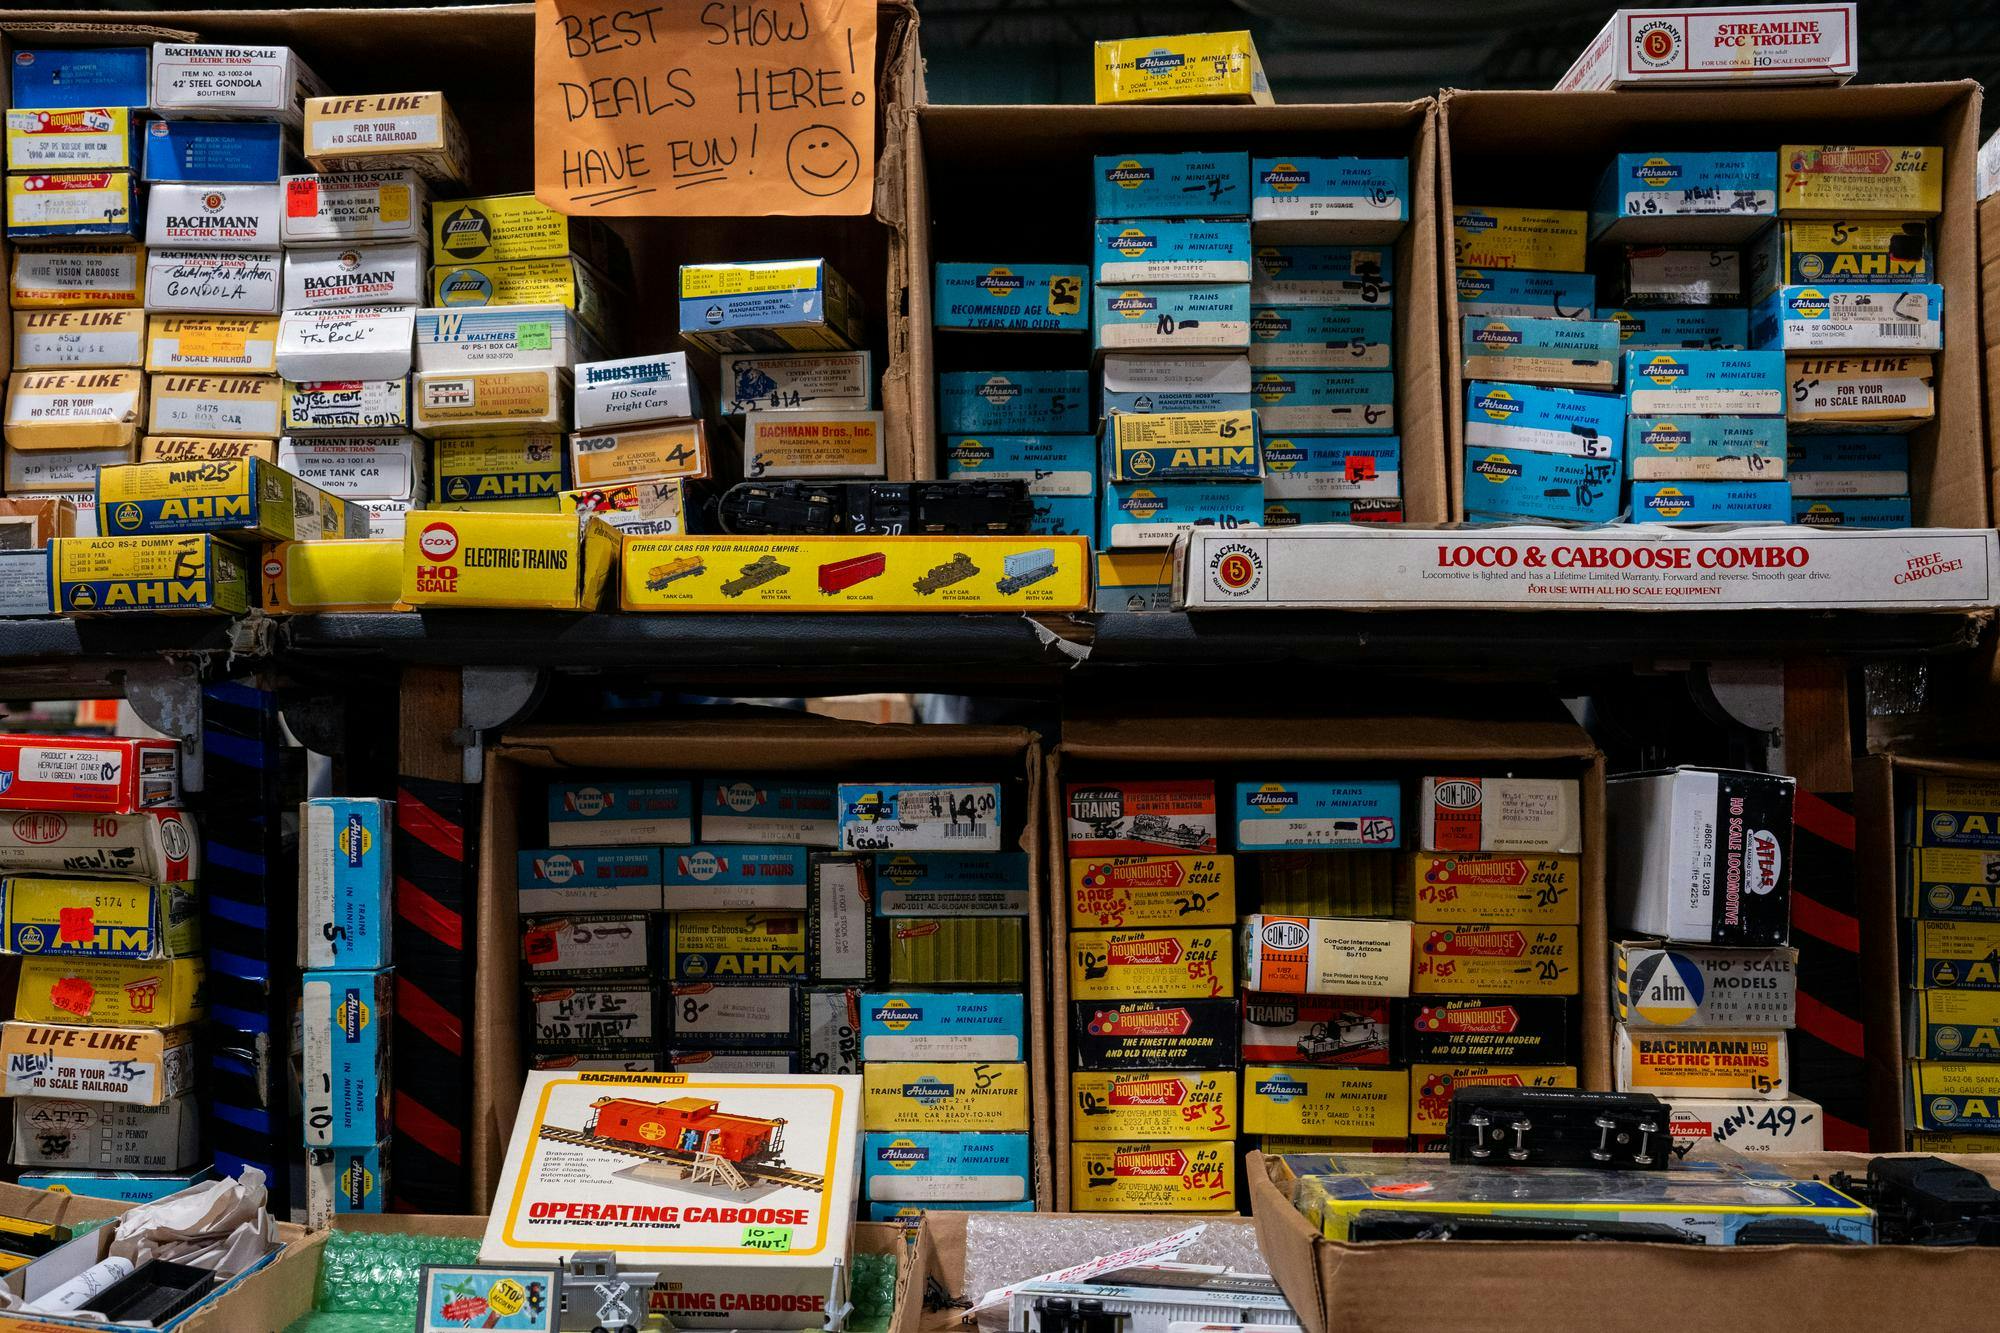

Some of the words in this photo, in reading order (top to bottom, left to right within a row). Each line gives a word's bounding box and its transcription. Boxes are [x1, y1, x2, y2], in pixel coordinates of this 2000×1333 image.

[556, 7, 663, 58] BEST
[701, 2, 810, 46] SHOW
[1633, 21, 1683, 45] BACHMANN
[1718, 21, 1820, 35] STREAMLINE
[1714, 35, 1745, 48] PCC
[1750, 33, 1822, 48] TROLLEY
[165, 47, 222, 57] BACHMANN
[225, 49, 241, 58] HO
[243, 49, 277, 58] SCALE
[189, 79, 212, 88] STEEL
[215, 79, 263, 89] GONDOLA
[558, 68, 696, 121] DEALS
[320, 96, 423, 115] LIFE-LIKE
[353, 124, 369, 132] FOR
[372, 122, 396, 131] YOUR
[331, 136, 344, 144] HO
[346, 134, 373, 143] SCALE
[375, 132, 418, 143] RAILROAD
[562, 143, 651, 190] HAVE
[166, 215, 259, 228] BACHMANN
[166, 229, 214, 237] ELECTRIC
[216, 228, 257, 237] TRAINS
[55, 267, 84, 277] VISION
[86, 268, 121, 278] CABOOSE
[167, 281, 247, 299] GONDOLA
[951, 304, 1022, 316] RECOMMENDED
[1024, 304, 1043, 315] AGE
[976, 318, 1005, 329] YEARS
[1008, 318, 1029, 329] AND
[1031, 318, 1061, 329] OLDER
[466, 332, 516, 342] WALTHERS
[586, 362, 670, 383] INDUSTRIAL
[1642, 364, 1686, 376] Athearn
[1802, 357, 1909, 375] LIFE-LIKE
[1706, 371, 1715, 379] IN
[1719, 370, 1768, 379] MINIATURE
[611, 390, 627, 400] HO
[629, 387, 658, 399] Scale
[1837, 386, 1855, 396] FOR
[1858, 385, 1883, 394] YOUR
[605, 400, 642, 413] Freight
[643, 398, 669, 410] Cars
[1815, 398, 1828, 407] HO
[1831, 396, 1858, 406] SCALE
[1861, 394, 1907, 405] RAILROAD
[159, 495, 250, 520] AHM
[91, 540, 115, 549] ALCO
[118, 540, 138, 549] RS-2
[141, 538, 175, 549] DUMMY
[424, 537, 454, 547] COX
[632, 543, 656, 553] OTHER
[657, 544, 671, 553] COX
[672, 544, 693, 553] CARS
[695, 544, 709, 553] FOR
[711, 544, 731, 553] YOUR
[732, 544, 770, 554] RAILROAD
[464, 548, 521, 570] ELECTRIC
[522, 549, 568, 571] TRAINS
[1210, 543, 1264, 570] BACHMANN
[1438, 546, 1518, 568] LOCO
[1523, 546, 1547, 568] &
[1551, 546, 1691, 569] CABOOSE
[1697, 546, 1810, 569] COMBO
[1906, 551, 1944, 569] FREE
[415, 566, 458, 579] HO
[1422, 570, 1470, 580] Locomotive
[1472, 571, 1479, 579] is
[1481, 571, 1509, 581] lighted
[1511, 571, 1527, 580] and
[1529, 571, 1543, 580] has
[1553, 571, 1587, 580] Lifetime
[1589, 571, 1619, 581] Limited
[1663, 572, 1697, 581] Forward
[1699, 572, 1716, 581] and
[1752, 571, 1785, 581] Smooth
[1787, 573, 1805, 582] gear
[1893, 558, 1964, 586] CABOOSE!
[415, 579, 458, 593] SCALE
[1528, 586, 1548, 595] FOR
[1550, 586, 1567, 594] USE
[1569, 586, 1595, 595] WITH
[1596, 587, 1615, 595] ALL
[1616, 587, 1630, 595] HO
[1633, 587, 1663, 595] SCALE
[1665, 586, 1722, 596] EQUIPMENT
[104, 581, 208, 606] AHM
[1730, 797, 1744, 816] HO
[1728, 818, 1744, 852] SCALE
[1755, 836, 1775, 890] ATLAS
[1702, 873, 1711, 896] U23B
[1725, 853, 1743, 925] LOCOMOTIVE
[1267, 926, 1305, 943] CON-COR
[1744, 960, 1790, 972] SCALE
[1651, 974, 1686, 1004] ahm
[1713, 977, 1777, 989] MODELS
[27, 1029, 143, 1051] LIFE-LIKE
[1123, 1037, 1138, 1047] THE
[1139, 1037, 1166, 1047] FINEST
[1168, 1037, 1176, 1046] IN
[1178, 1037, 1213, 1046] MODERN
[1639, 1040, 1749, 1054] BACHMANN
[1105, 1048, 1122, 1058] AND
[1123, 1048, 1139, 1058] OLD
[1141, 1048, 1166, 1058] TIMER
[1168, 1048, 1188, 1058] KITS
[11, 1049, 54, 1073] NEW!
[1639, 1054, 1712, 1067] ELECTRIC
[1715, 1054, 1769, 1067] TRAINS
[58, 1067, 75, 1078] FOR
[77, 1069, 106, 1080] YOUR
[580, 1073, 663, 1085] BACHMANN
[33, 1078, 47, 1087] HO
[49, 1078, 80, 1091] SCALE
[82, 1081, 128, 1094] RAILROAD
[870, 1087, 902, 1096] TRAINS
[905, 1085, 951, 1097] Athearn
[955, 1087, 966, 1096] IN
[969, 1086, 1019, 1096] MINIATURE
[1714, 1105, 1754, 1142] NEW!
[528, 1202, 679, 1223] OPERATING
[682, 1207, 809, 1225] CABOOSE
[564, 1219, 612, 1228] PICK-UP
[613, 1221, 681, 1230] PLATFORM
